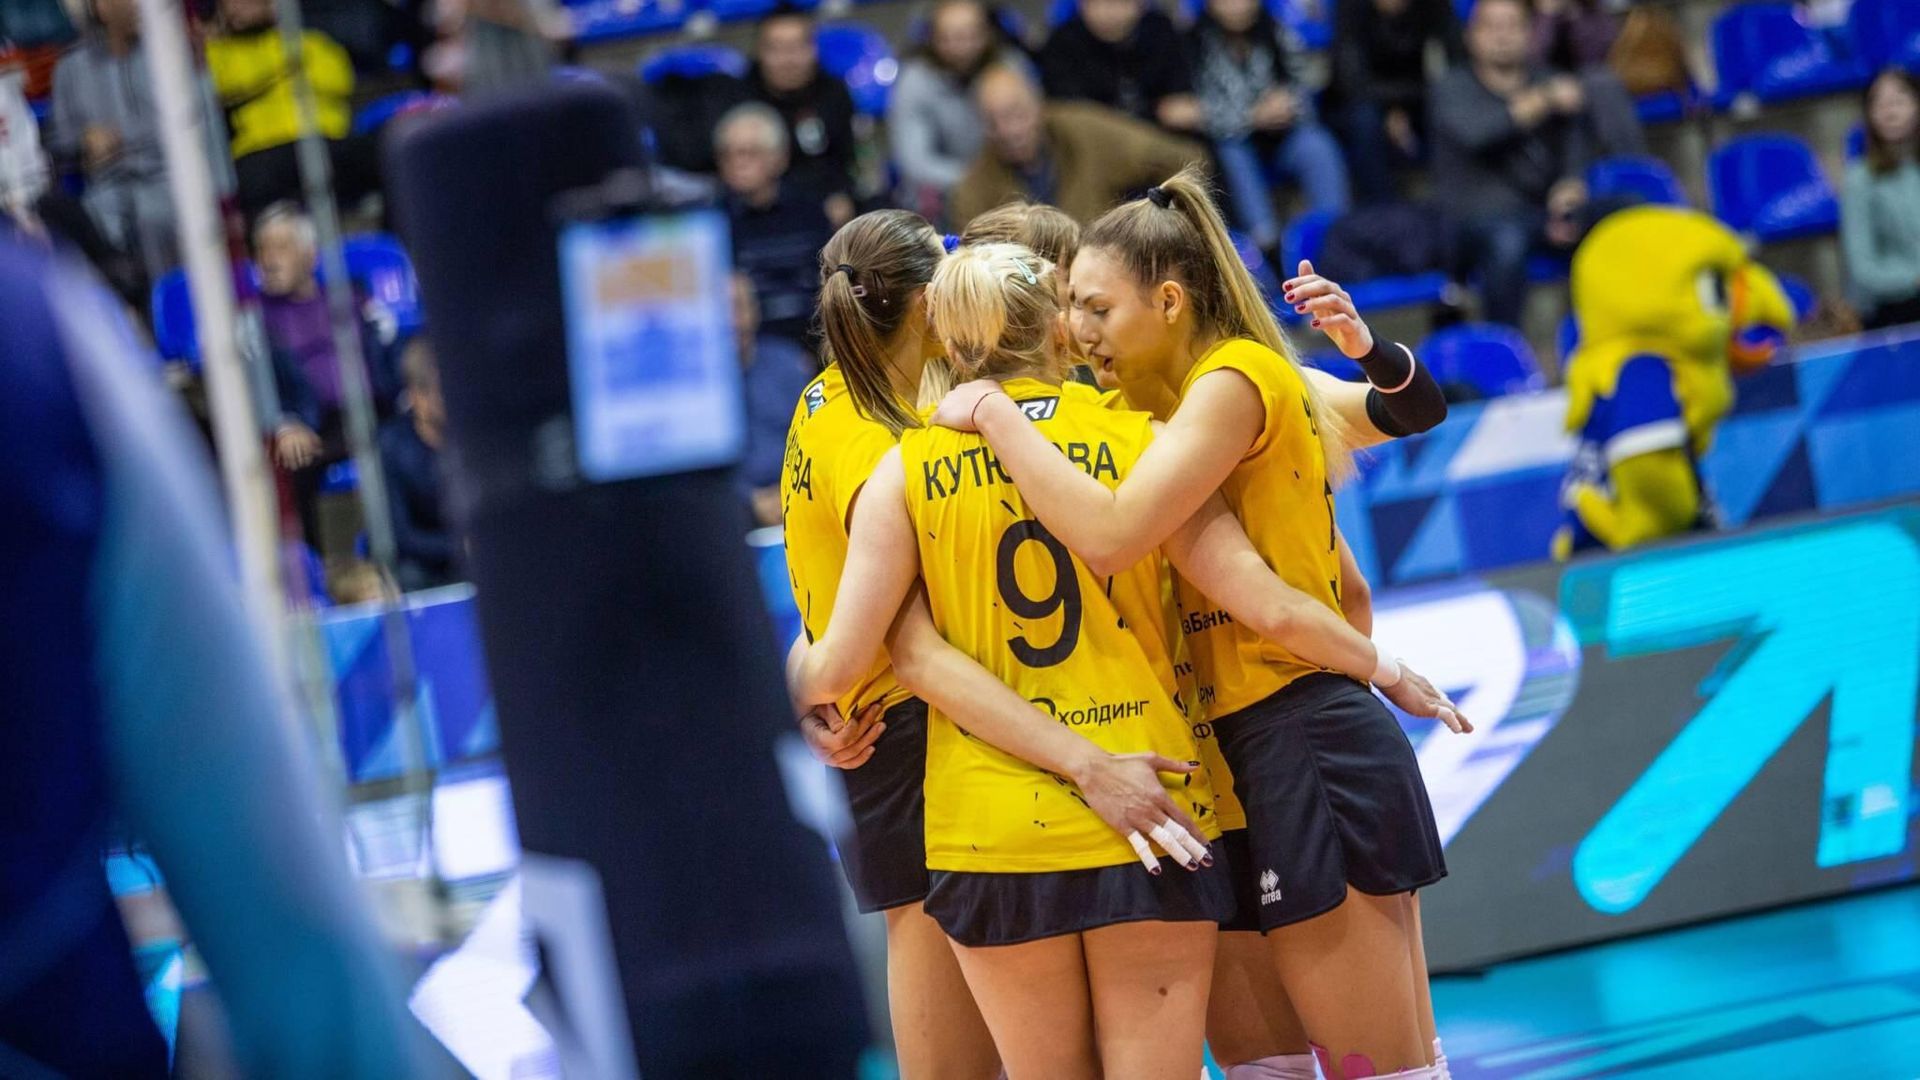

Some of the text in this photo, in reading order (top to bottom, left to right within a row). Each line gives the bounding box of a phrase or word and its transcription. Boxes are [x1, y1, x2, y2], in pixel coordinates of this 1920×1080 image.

[923, 441, 1119, 501] КУТЮВА
[996, 519, 1083, 669] 9
[1059, 700, 1150, 727] холдинг
